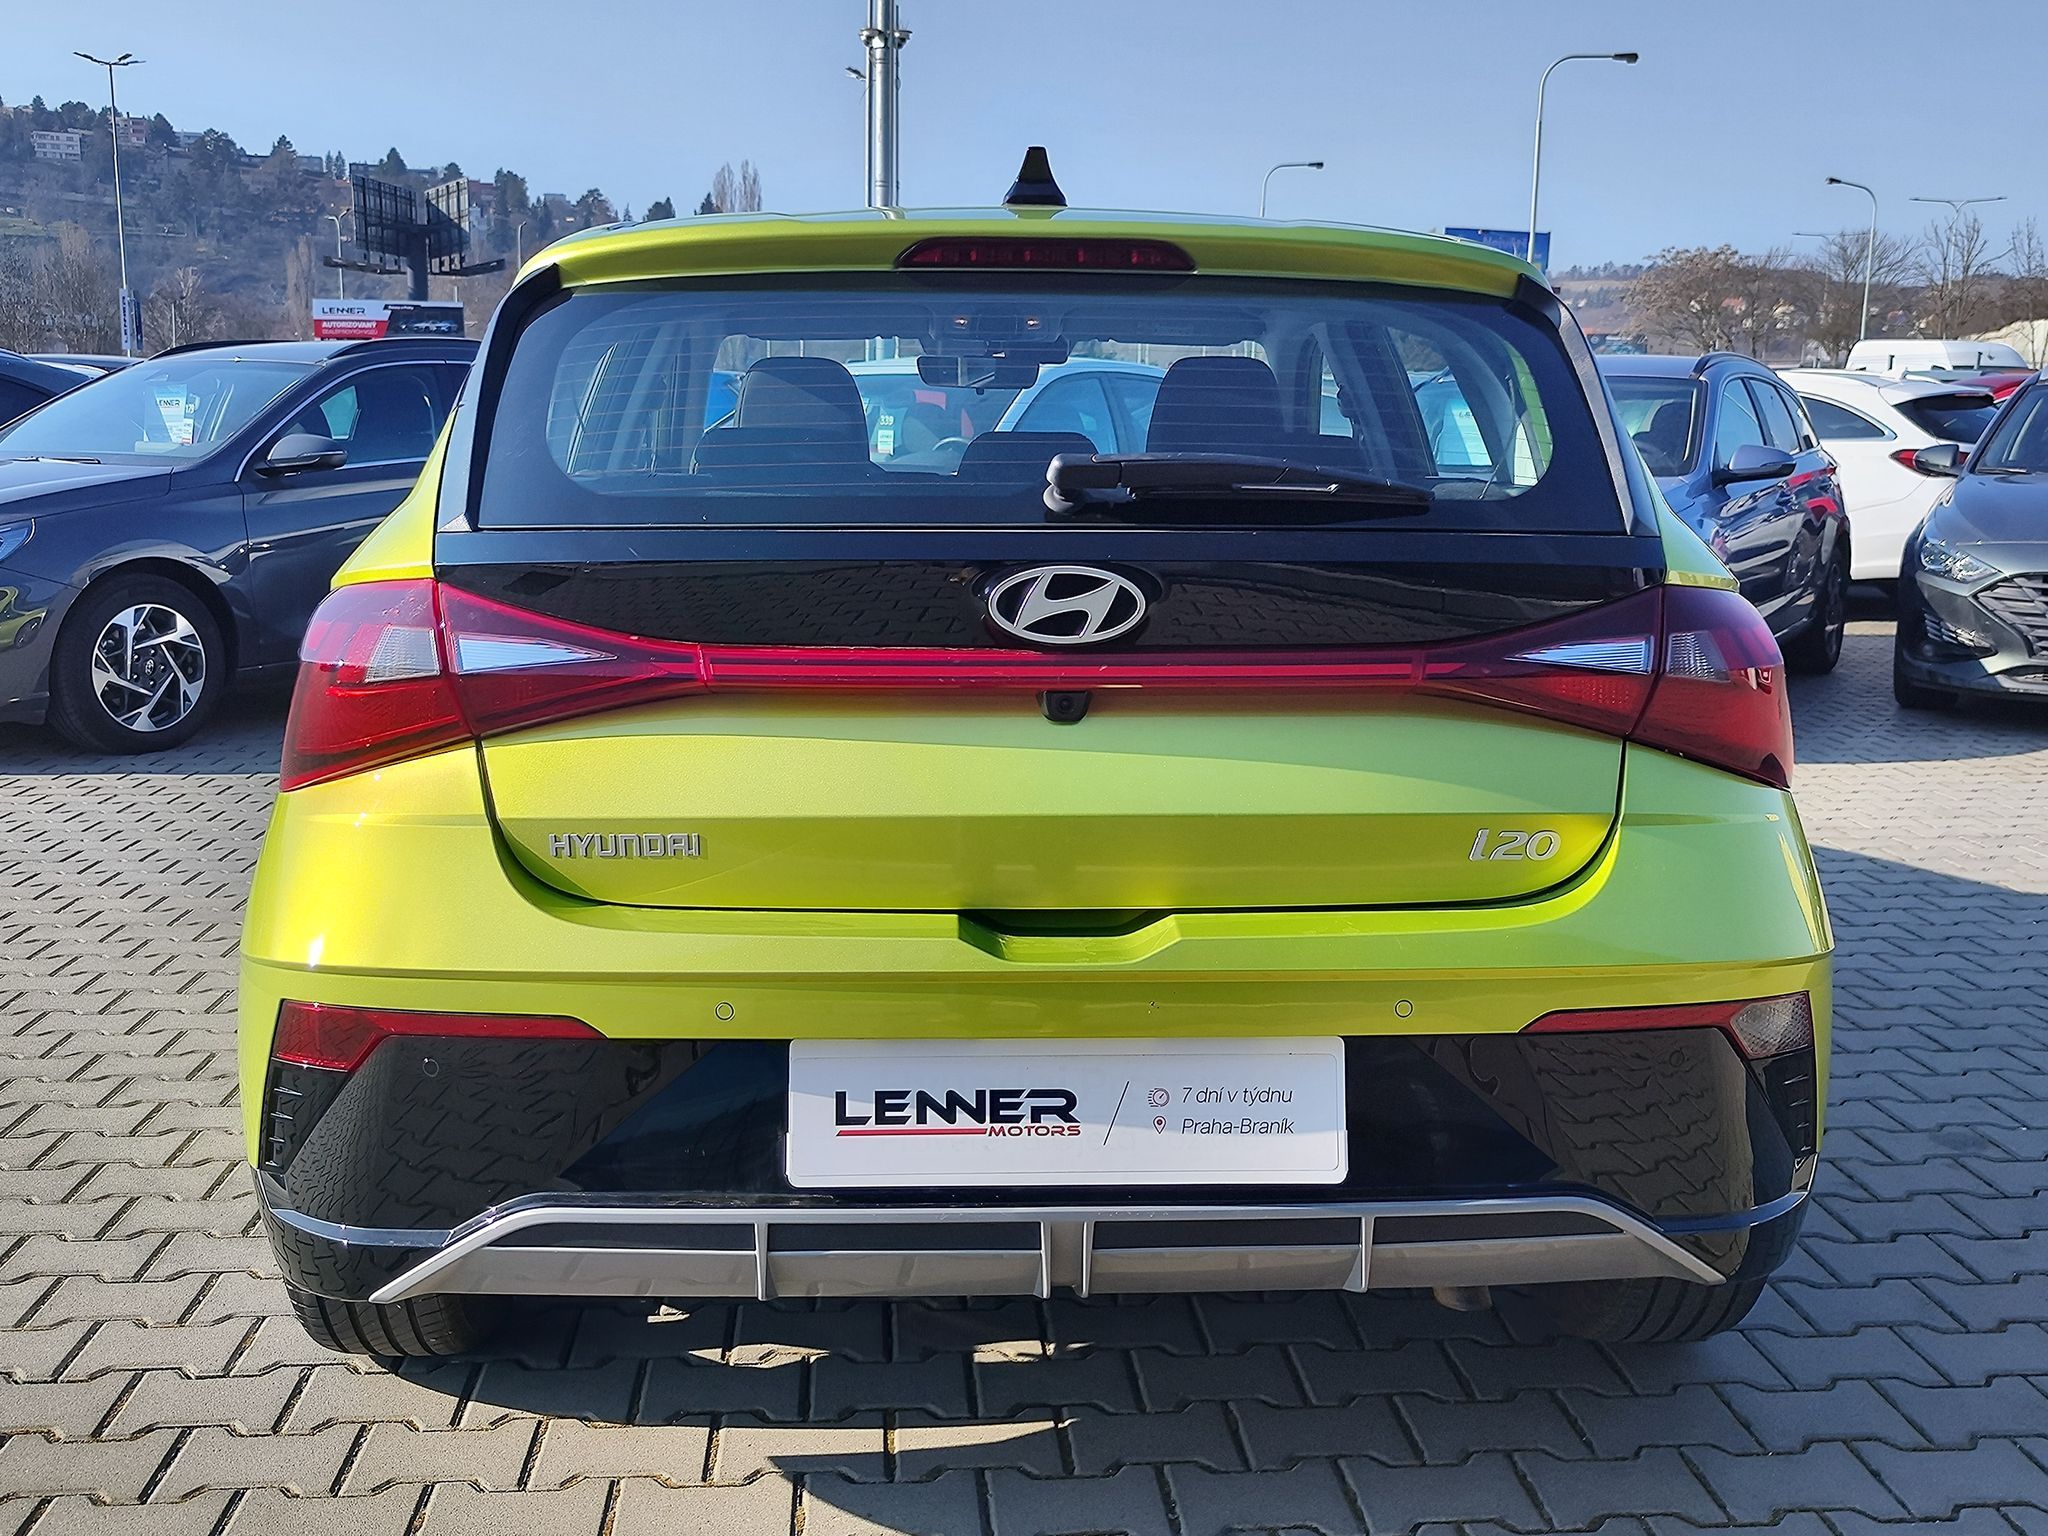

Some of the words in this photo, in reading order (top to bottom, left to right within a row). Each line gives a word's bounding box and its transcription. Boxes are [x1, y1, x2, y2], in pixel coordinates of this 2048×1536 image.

[549, 833, 701, 858] HYUNDAI
[835, 1089, 1081, 1125] LENNER
[1182, 1086, 1193, 1103] 7
[1196, 1086, 1225, 1103] dní
[1227, 1090, 1239, 1103] v
[1243, 1086, 1293, 1107] týdnu
[988, 1125, 1082, 1137] MOTORS
[1181, 1117, 1295, 1135] Praha-Braník
